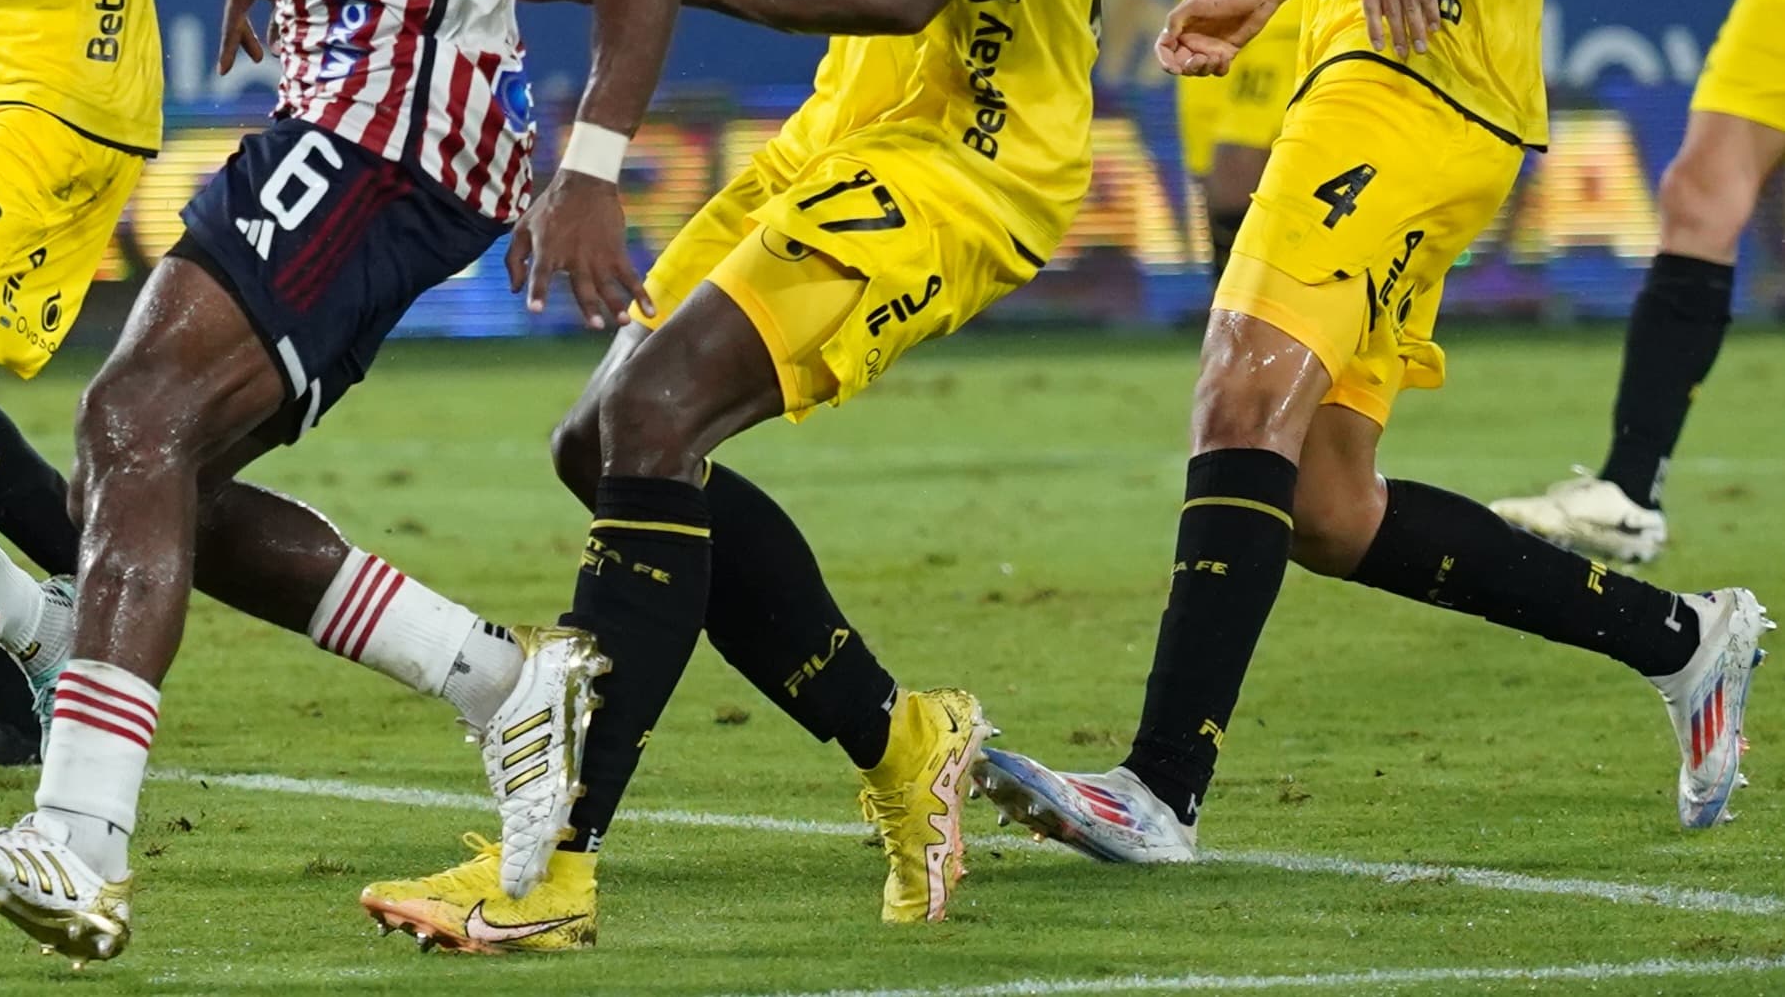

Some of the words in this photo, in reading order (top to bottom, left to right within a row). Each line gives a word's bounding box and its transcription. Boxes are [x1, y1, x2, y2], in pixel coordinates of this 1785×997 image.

[260, 130, 343, 231] 6
[796, 168, 907, 234] 17
[1312, 163, 1378, 231] 4
[1379, 230, 1425, 307] FILA
[865, 274, 942, 338] FILA
[783, 627, 850, 699] FILA
